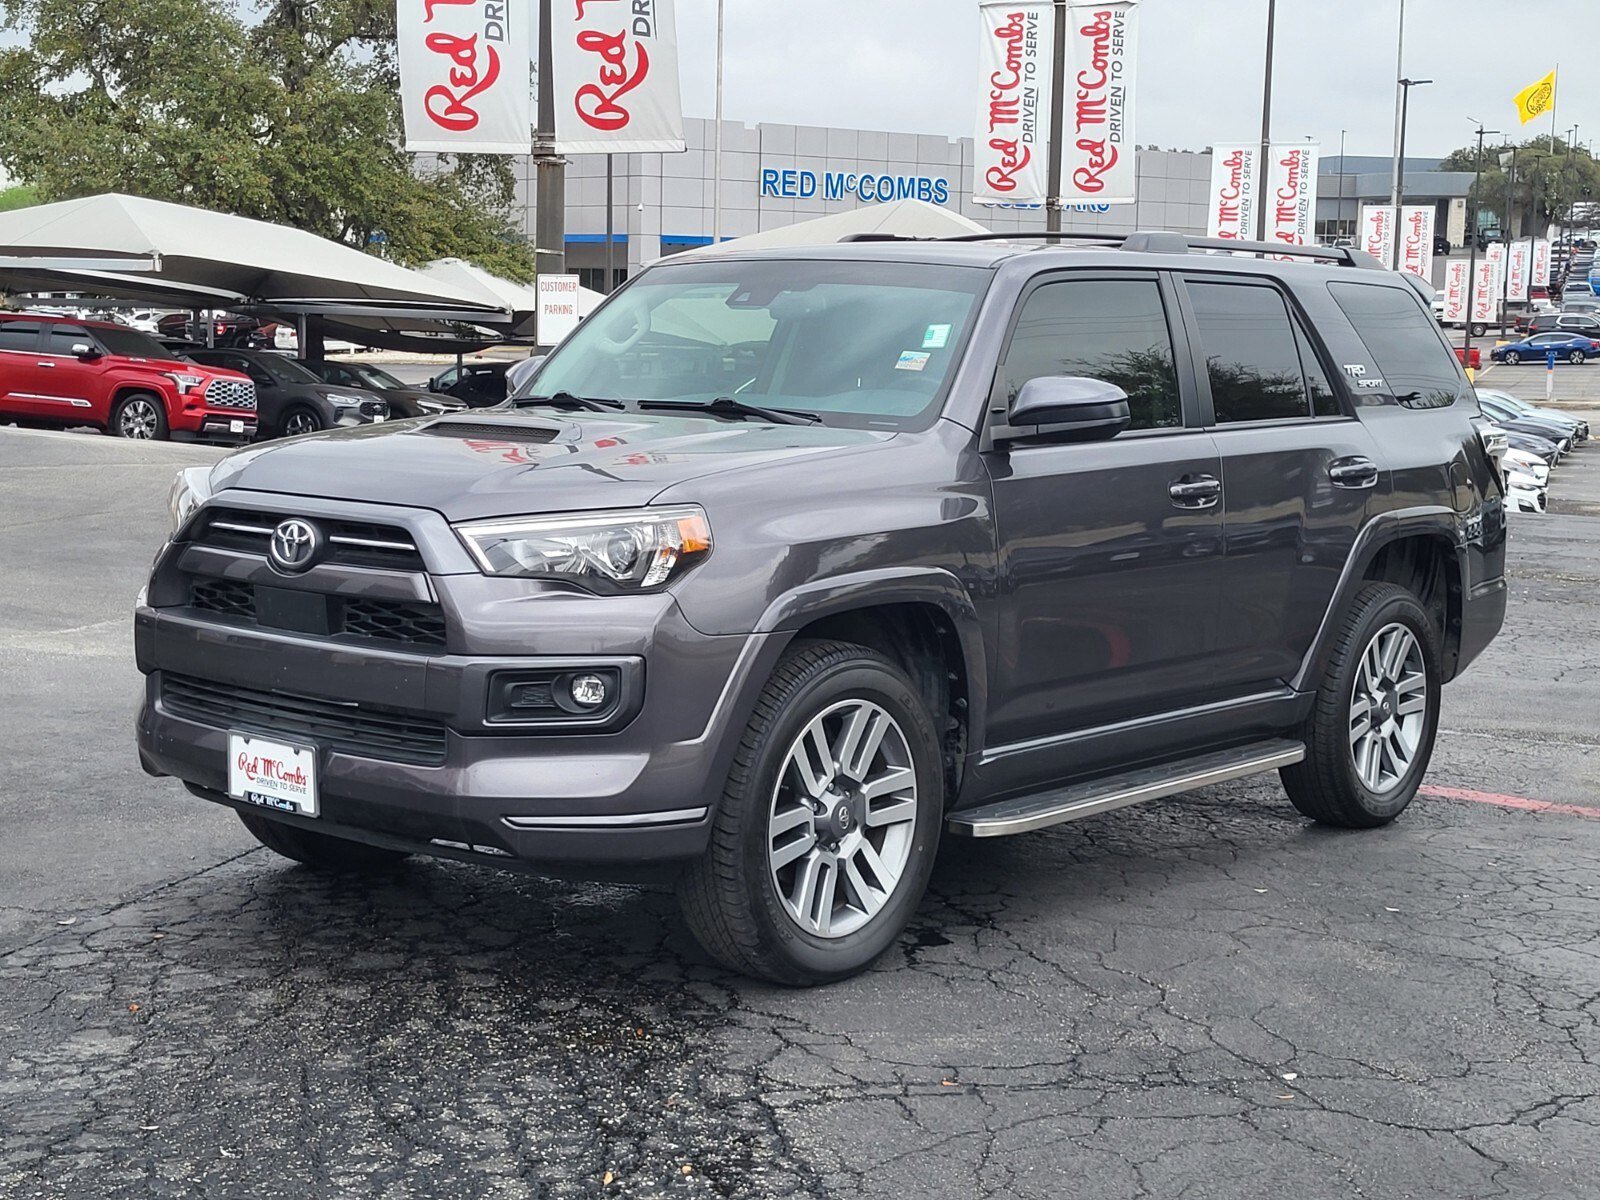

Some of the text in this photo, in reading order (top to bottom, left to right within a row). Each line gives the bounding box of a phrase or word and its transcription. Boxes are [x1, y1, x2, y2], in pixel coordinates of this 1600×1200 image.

[424, 32, 500, 131] Red
[575, 29, 649, 131] Red
[1022, 12, 1038, 143] DRIVEN TO SERVE
[1110, 11, 1125, 143] DRIVEN TO SERVE
[762, 169, 816, 197] RED
[986, 138, 1031, 191] Red
[1073, 138, 1118, 192] Red
[1240, 150, 1252, 235] DRIVEN TO SERVE
[1297, 149, 1310, 235] DRIVEN TO SERVE
[541, 281, 577, 292] CUSTOMER
[544, 304, 573, 315] PARKING
[1343, 364, 1366, 377] TRD
[1357, 379, 1383, 388] SPORT
[238, 752, 259, 781] Red
[256, 777, 307, 794] DRIVEN TO SERVE
[251, 793, 264, 805] Red
